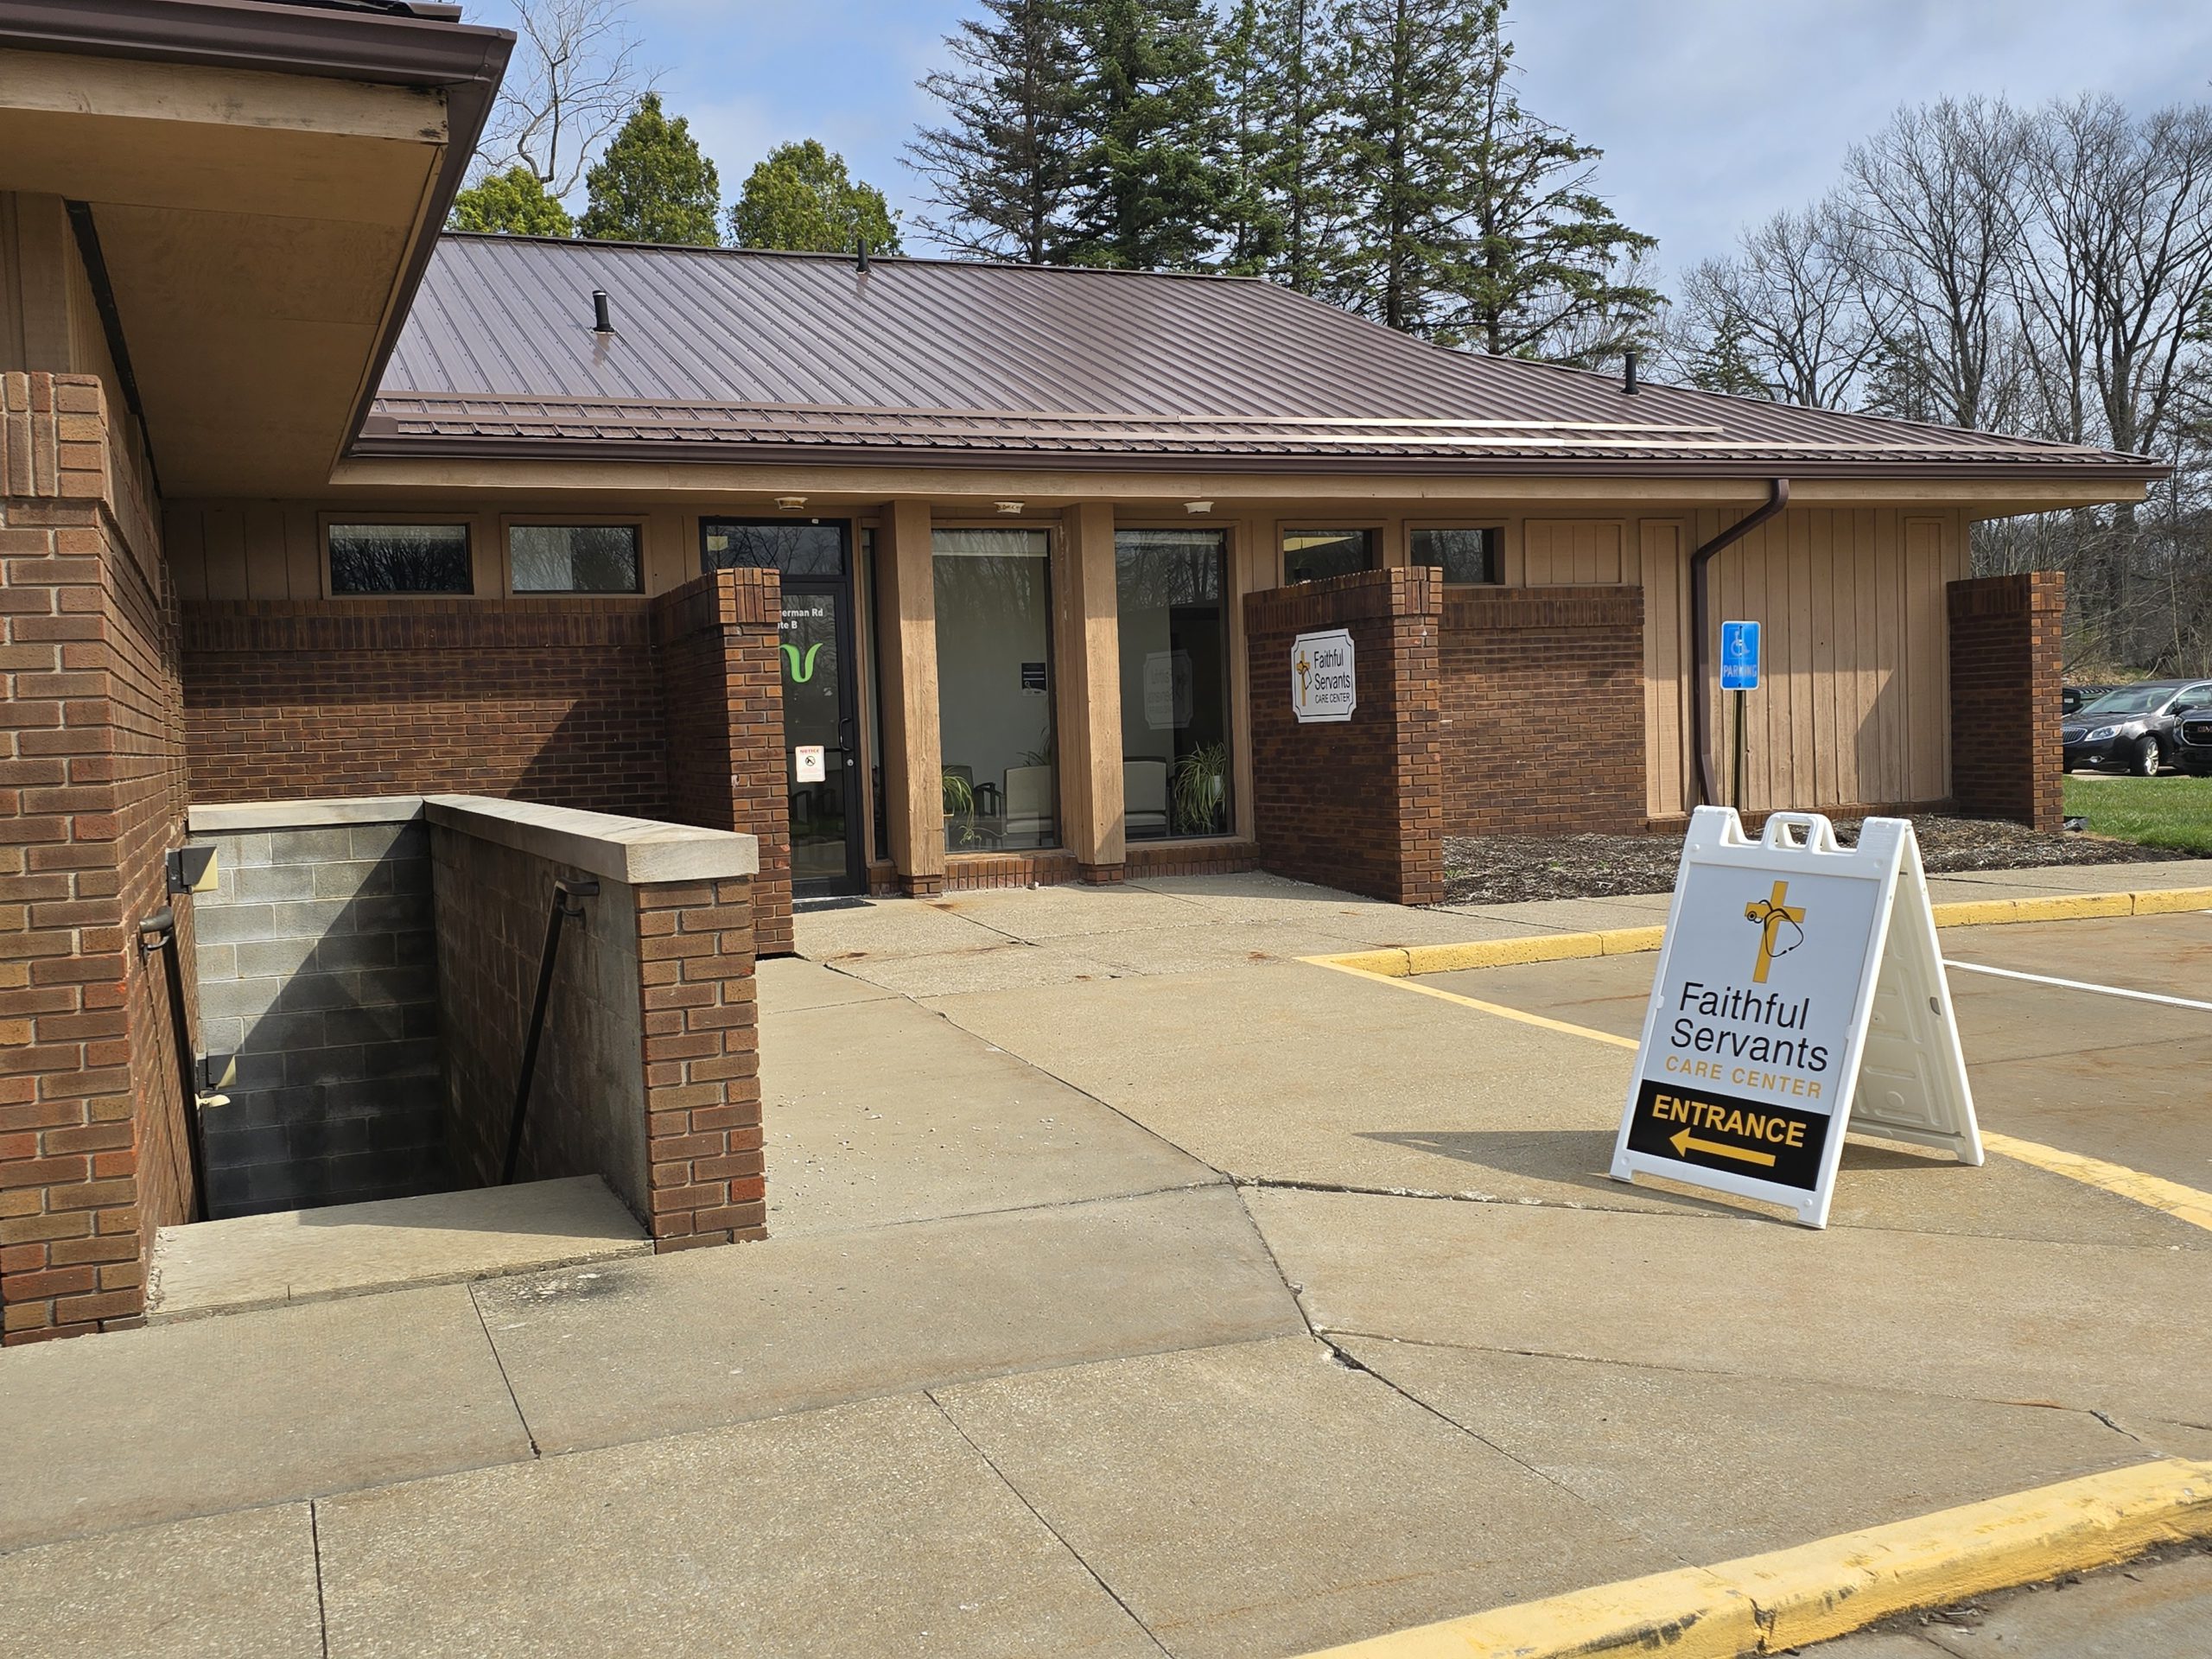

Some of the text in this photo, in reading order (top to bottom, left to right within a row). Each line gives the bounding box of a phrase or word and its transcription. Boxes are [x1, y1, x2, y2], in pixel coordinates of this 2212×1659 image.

[780, 607, 823, 617] erman Rd
[791, 620, 798, 629] B
[1314, 649, 1344, 669] Faithful
[1723, 664, 1757, 677] PARKING
[1314, 671, 1351, 690] Servants
[1315, 692, 1351, 703] CARE CENTER
[1679, 982, 1810, 1030] Faithful
[1670, 1018, 1829, 1071] Servants
[1665, 1055, 1822, 1099] CARE CENTER
[1652, 1094, 1808, 1148] ENTRANCE
